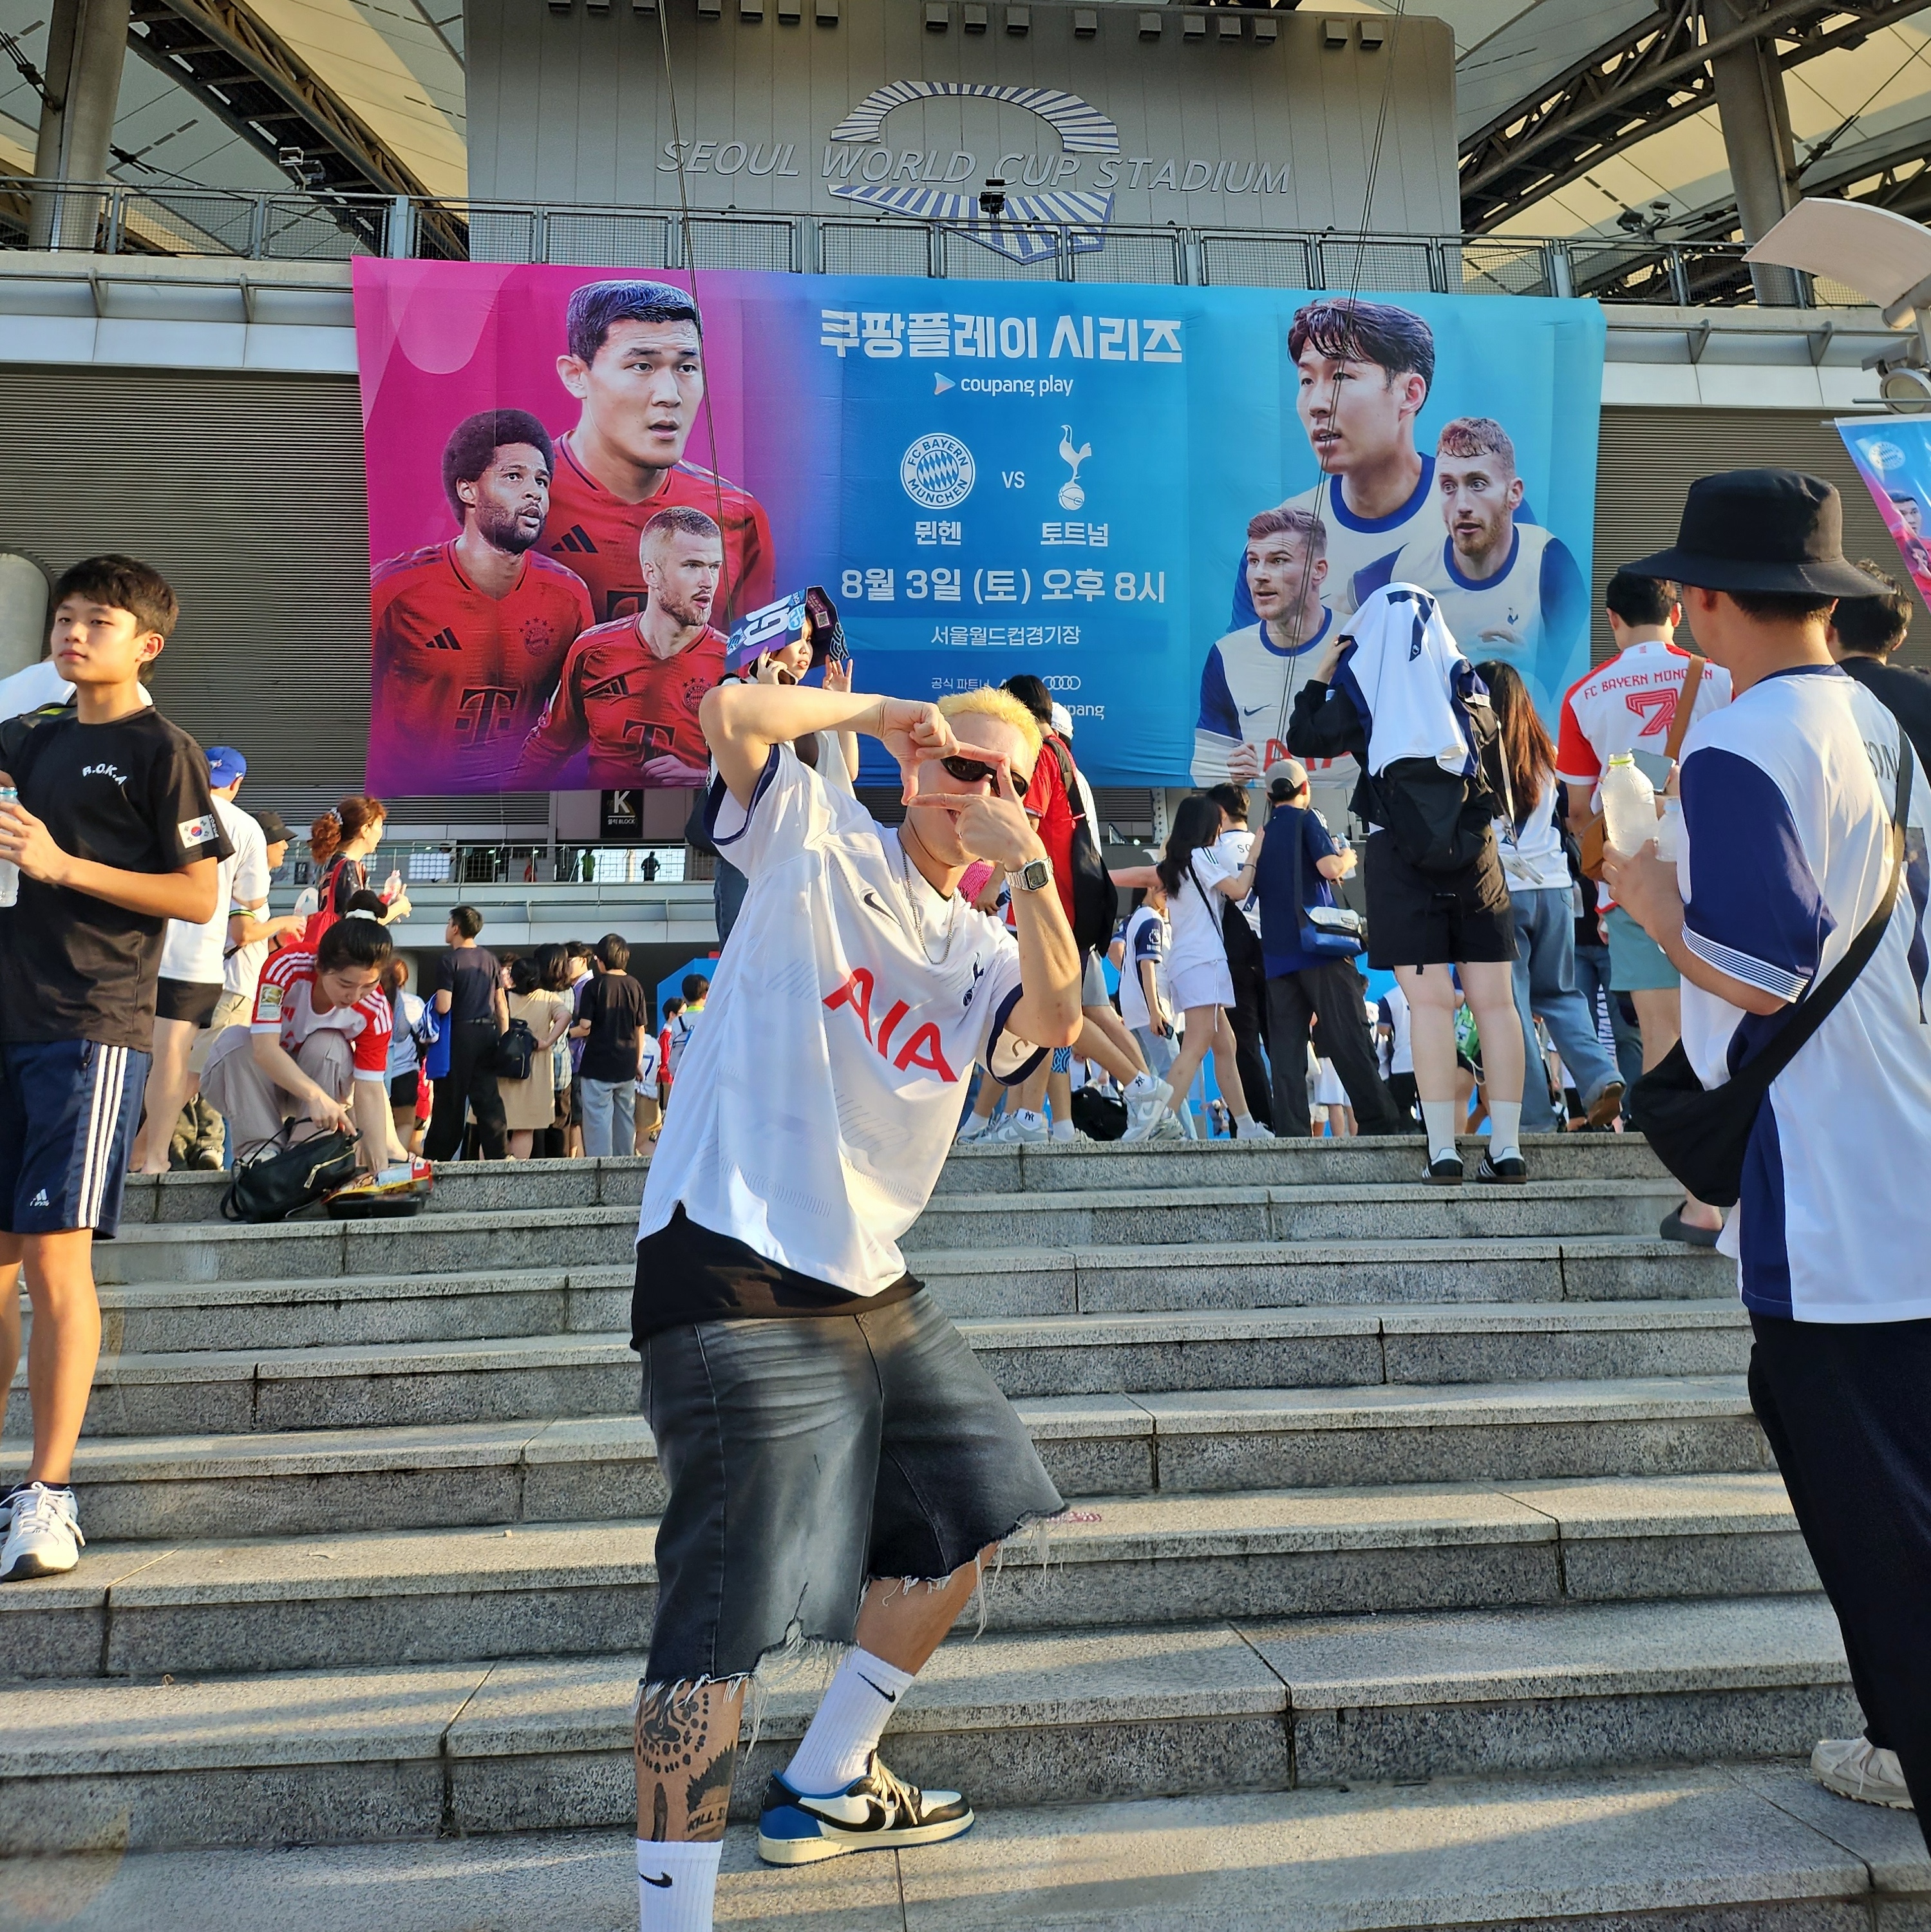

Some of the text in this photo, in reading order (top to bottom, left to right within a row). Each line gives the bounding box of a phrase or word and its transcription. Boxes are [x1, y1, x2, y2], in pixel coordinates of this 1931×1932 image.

[657, 140, 1290, 193] SEOUL WORLD CUP STADIUM
[821, 309, 1182, 363] 쿠팡플레이 시리즈
[961, 374, 1074, 397] coupang play
[907, 439, 968, 466] FC BAYERN
[907, 478, 968, 504] MÜNCHEN
[1001, 471, 1025, 489] VS
[914, 520, 961, 545] 뮌헨
[1041, 522, 1108, 547] 토트넘
[842, 567, 1164, 604] 8월 3일 (토) 오후 8시
[931, 625, 1081, 646] 서울월드컵경기장
[931, 677, 954, 689] 공식
[1584, 667, 1713, 700] FC BAYERN MÜNCN
[1064, 704, 1106, 720] pang
[614, 790, 631, 813] K
[824, 967, 959, 1083] AIA
